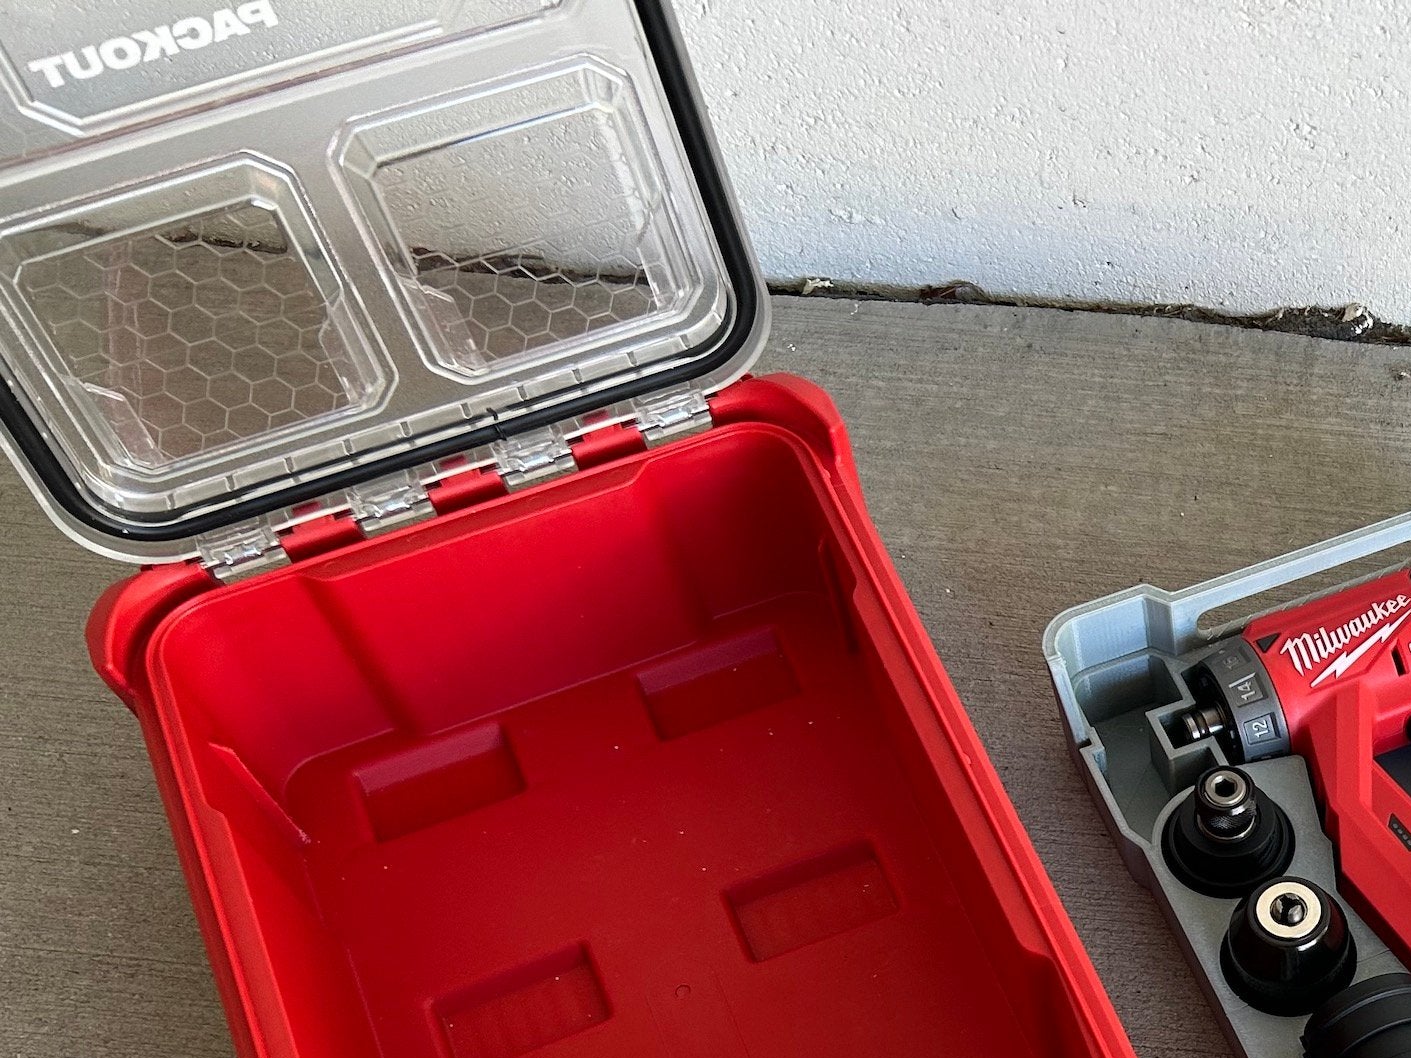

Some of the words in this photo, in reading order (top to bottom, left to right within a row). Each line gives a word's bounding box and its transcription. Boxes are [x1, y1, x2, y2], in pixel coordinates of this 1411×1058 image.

[1280, 593, 1411, 677] Milwaukee
[1237, 681, 1256, 701] 14
[1252, 719, 1271, 738] 12
